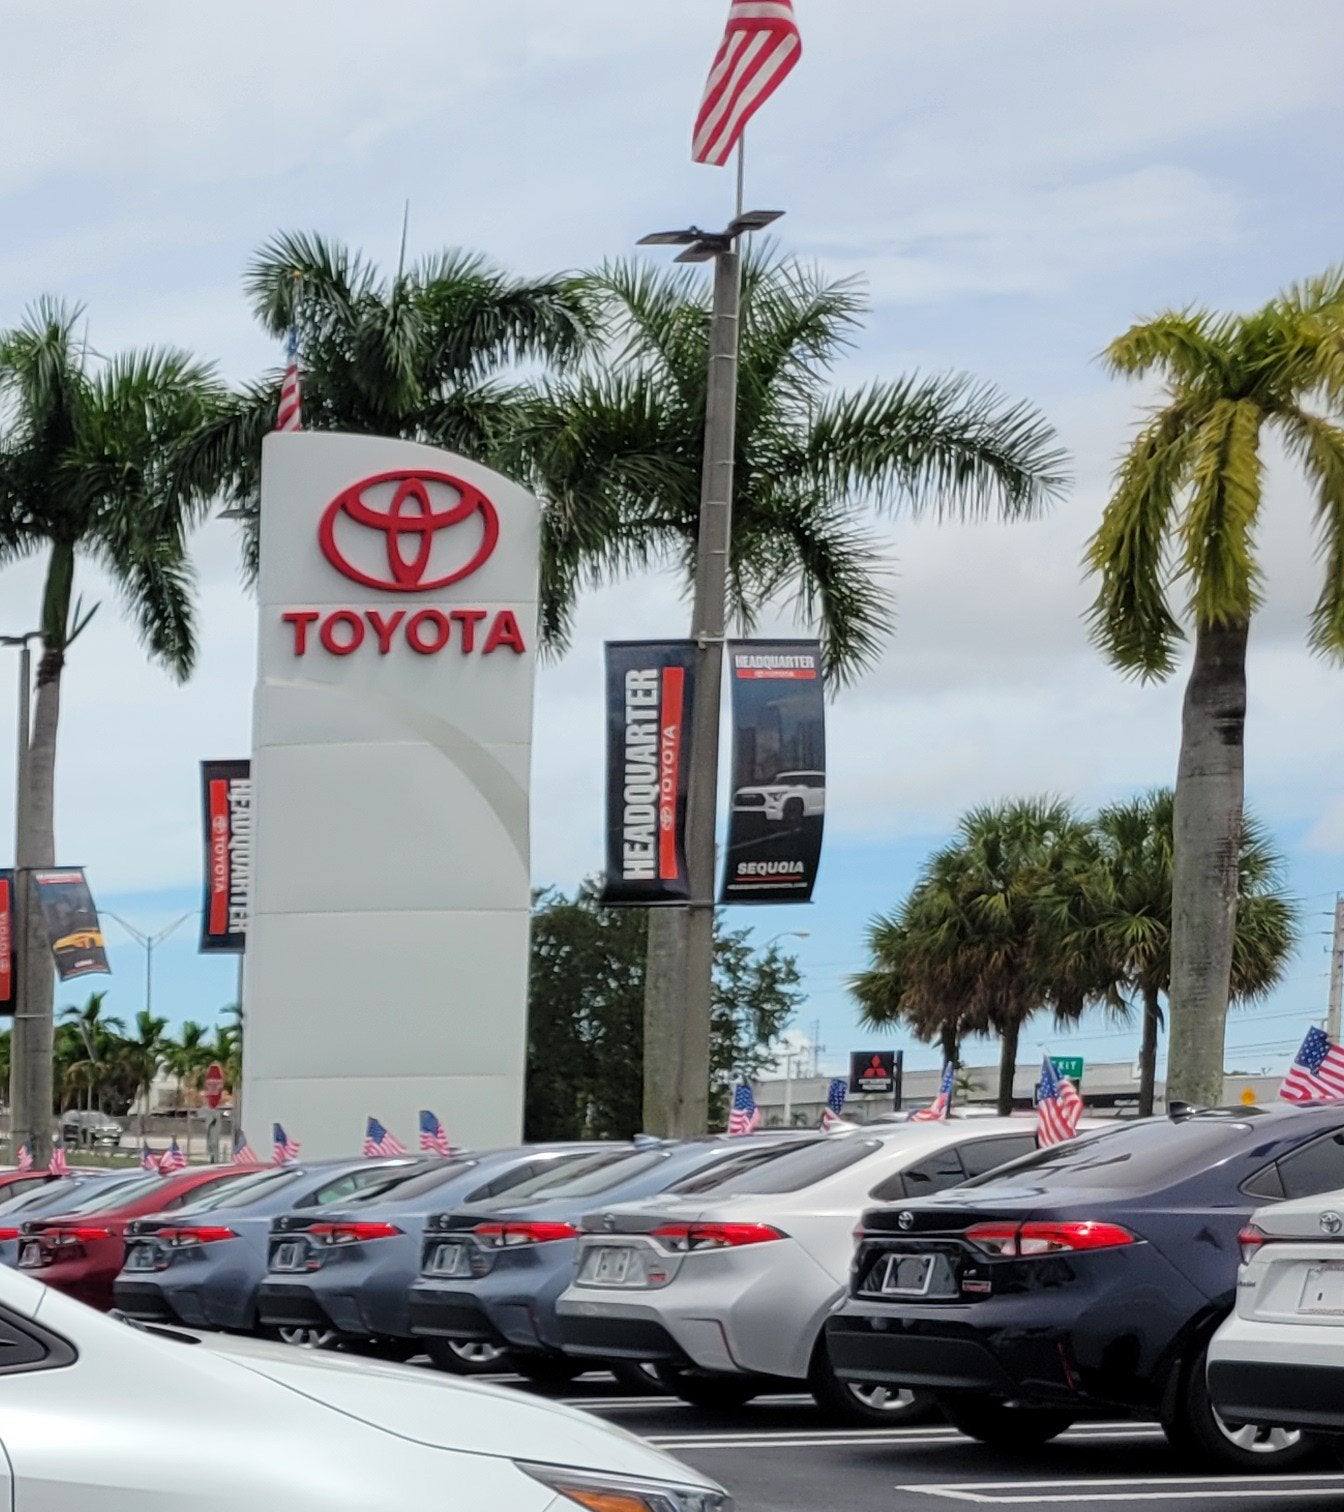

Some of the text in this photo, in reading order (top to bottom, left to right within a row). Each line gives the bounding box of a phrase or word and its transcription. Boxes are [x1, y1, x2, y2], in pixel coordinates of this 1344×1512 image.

[281, 609, 526, 657] TOYOTA
[735, 655, 814, 670] HEADQUARTER
[623, 668, 660, 880] HEADQUARTER
[661, 725, 677, 801] TOYOTA
[737, 861, 804, 876] SEQUOIA
